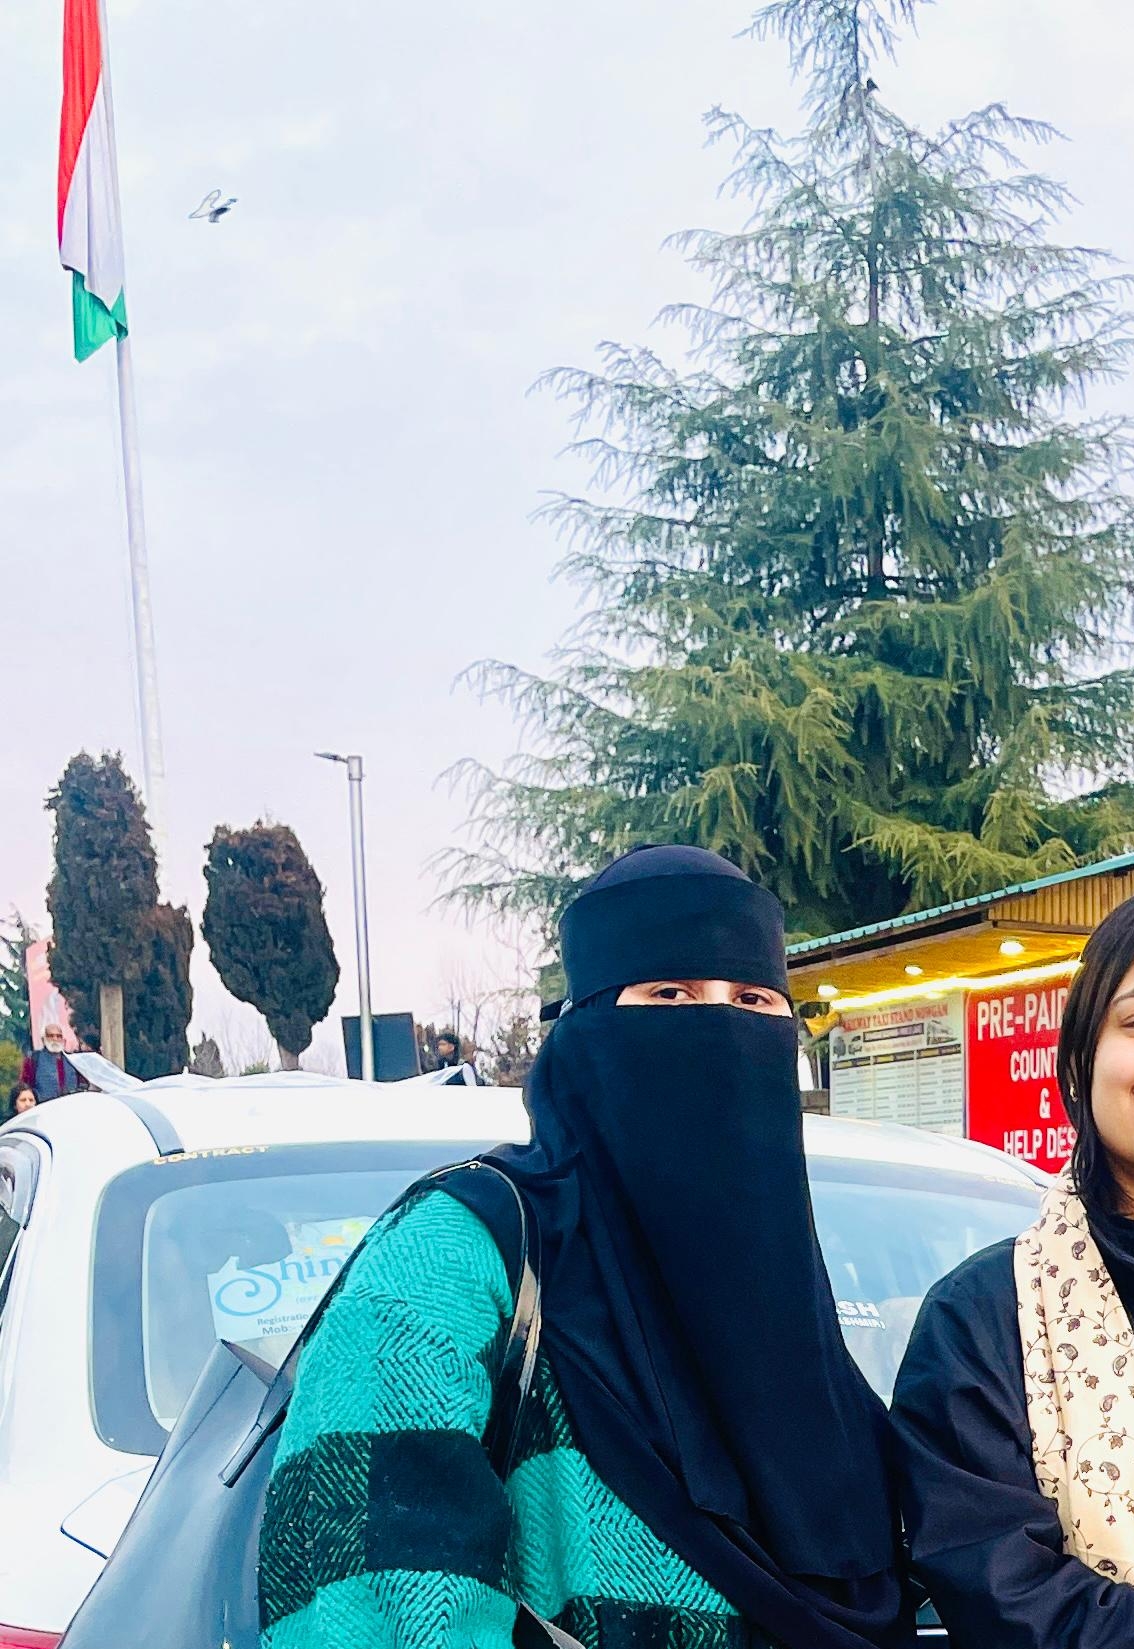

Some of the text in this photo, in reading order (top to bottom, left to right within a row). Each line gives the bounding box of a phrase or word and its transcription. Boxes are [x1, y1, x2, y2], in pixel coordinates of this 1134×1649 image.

[1010, 1045, 1058, 1082] COUNT
[1039, 1087, 1051, 1119] &
[153, 1145, 270, 1166] CONTRACT
[1003, 1125, 1078, 1160] HELP DES
[215, 1252, 349, 1317] Shin
[257, 1313, 309, 1327] Registratio
[836, 1300, 880, 1318] SH
